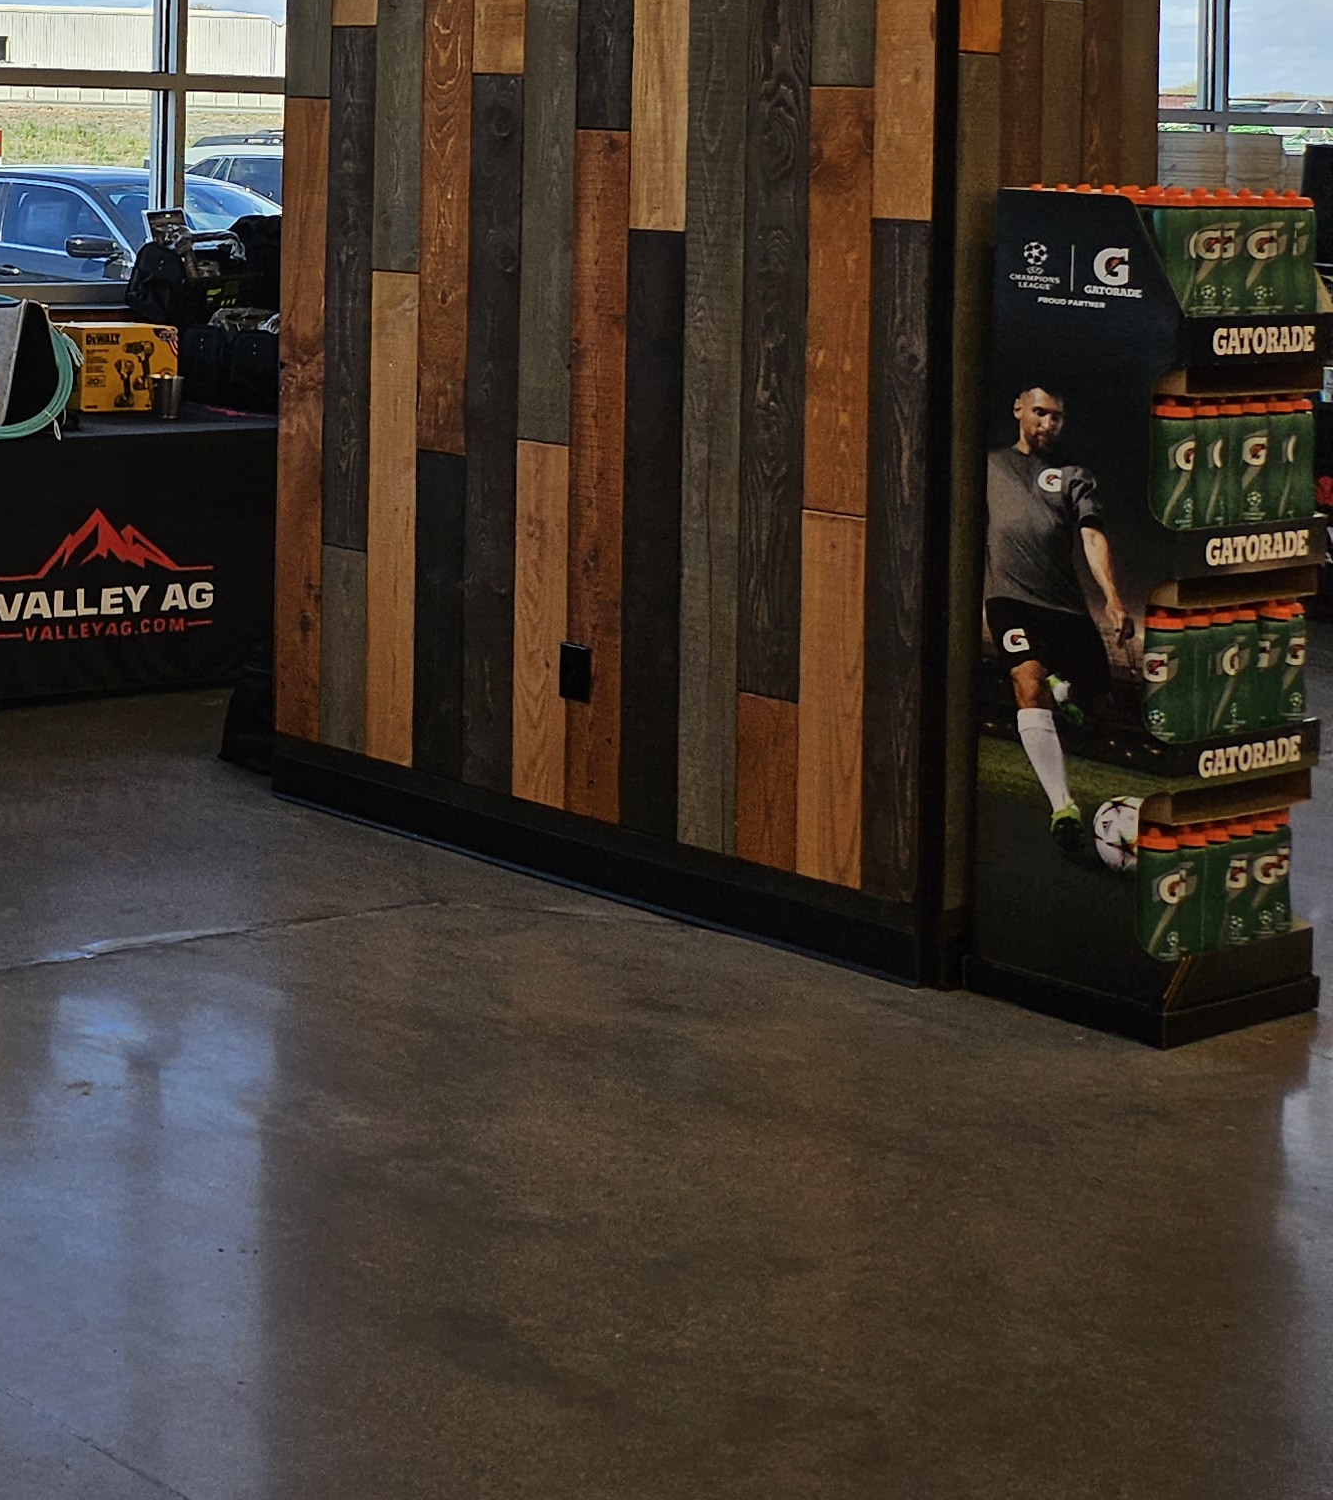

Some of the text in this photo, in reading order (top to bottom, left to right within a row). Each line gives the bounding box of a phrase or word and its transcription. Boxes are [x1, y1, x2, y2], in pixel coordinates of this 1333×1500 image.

[1009, 273, 1061, 284] CHAMPIONS
[1093, 247, 1129, 286] G
[1018, 281, 1051, 290] LEAGUE
[1083, 284, 1143, 299] GATORADE
[1037, 296, 1107, 309] PROUD PARTNER
[1212, 326, 1316, 355] GATORADE
[1205, 529, 1309, 566] GATORADE
[161, 581, 215, 611] AG
[24, 618, 186, 642] VALLEYAG.COM
[1198, 735, 1302, 779] GATORADE
